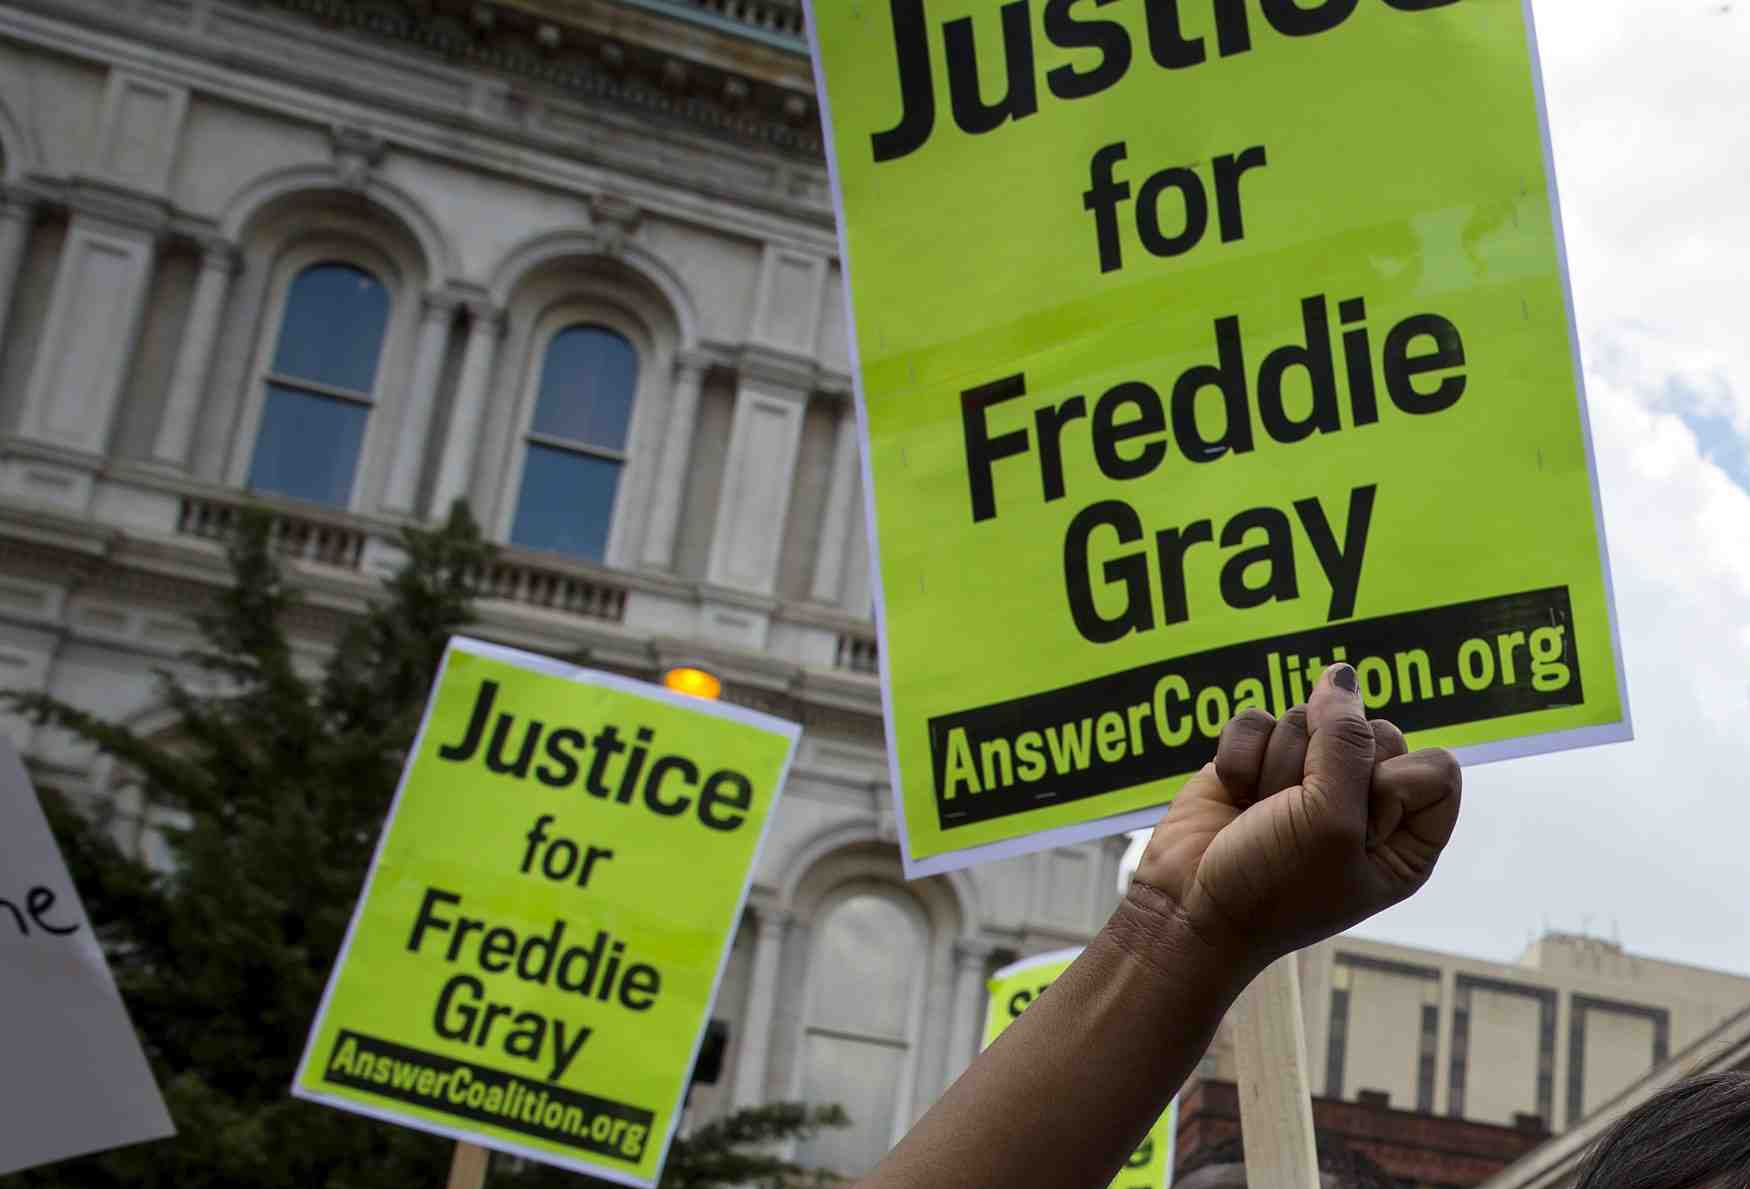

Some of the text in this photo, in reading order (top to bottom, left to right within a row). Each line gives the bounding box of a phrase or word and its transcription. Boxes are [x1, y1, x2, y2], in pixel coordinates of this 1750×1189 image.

[1083, 142, 1267, 273] for
[961, 294, 1467, 523] Freddie
[1063, 484, 1377, 644] Gray
[440, 682, 753, 832] Justice
[942, 623, 1571, 800] AnswerCoaliton.org
[521, 815, 614, 887] for
[407, 888, 661, 1012] Freddie
[433, 974, 592, 1082] Gray
[331, 1037, 648, 1156] AnswerCoalition.org
